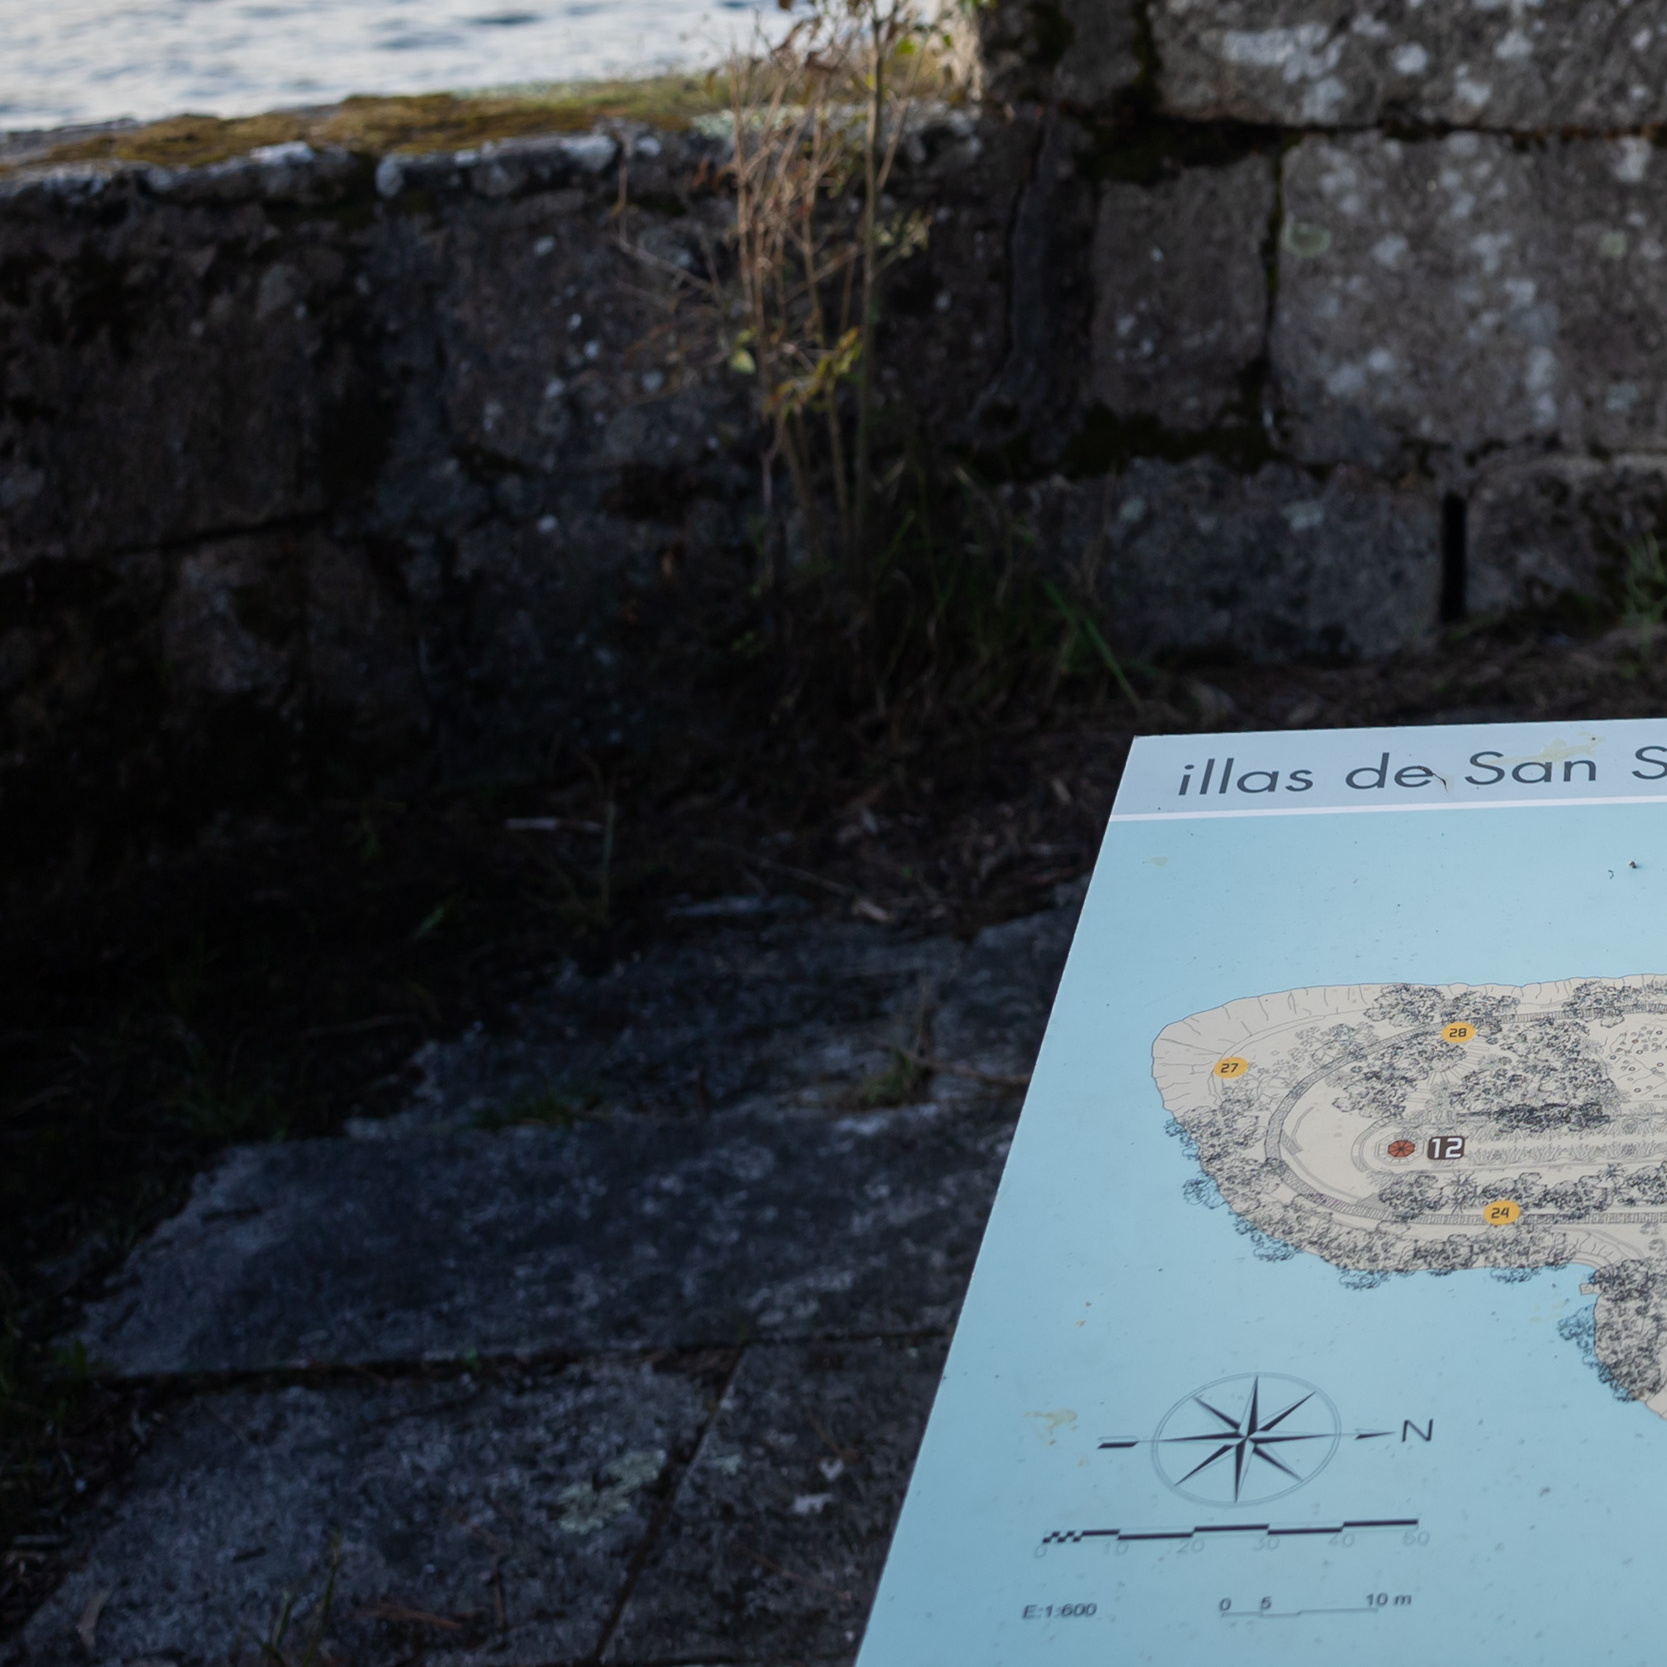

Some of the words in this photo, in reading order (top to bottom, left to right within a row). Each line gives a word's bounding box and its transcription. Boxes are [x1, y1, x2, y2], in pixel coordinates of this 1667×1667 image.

[1178, 757, 1314, 796] illas
[1345, 752, 1434, 789] de
[1465, 751, 1598, 786] San
[1449, 1028, 1467, 1038] 28
[1221, 1063, 1239, 1074] 27
[1432, 1138, 1463, 1159] 12
[1491, 1207, 1510, 1219] 24
[1402, 1419, 1433, 1442] N
[1220, 1598, 1231, 1611] 0
[1260, 1596, 1271, 1610] 5
[1365, 1593, 1388, 1606] 10
[1394, 1595, 1412, 1605] m
